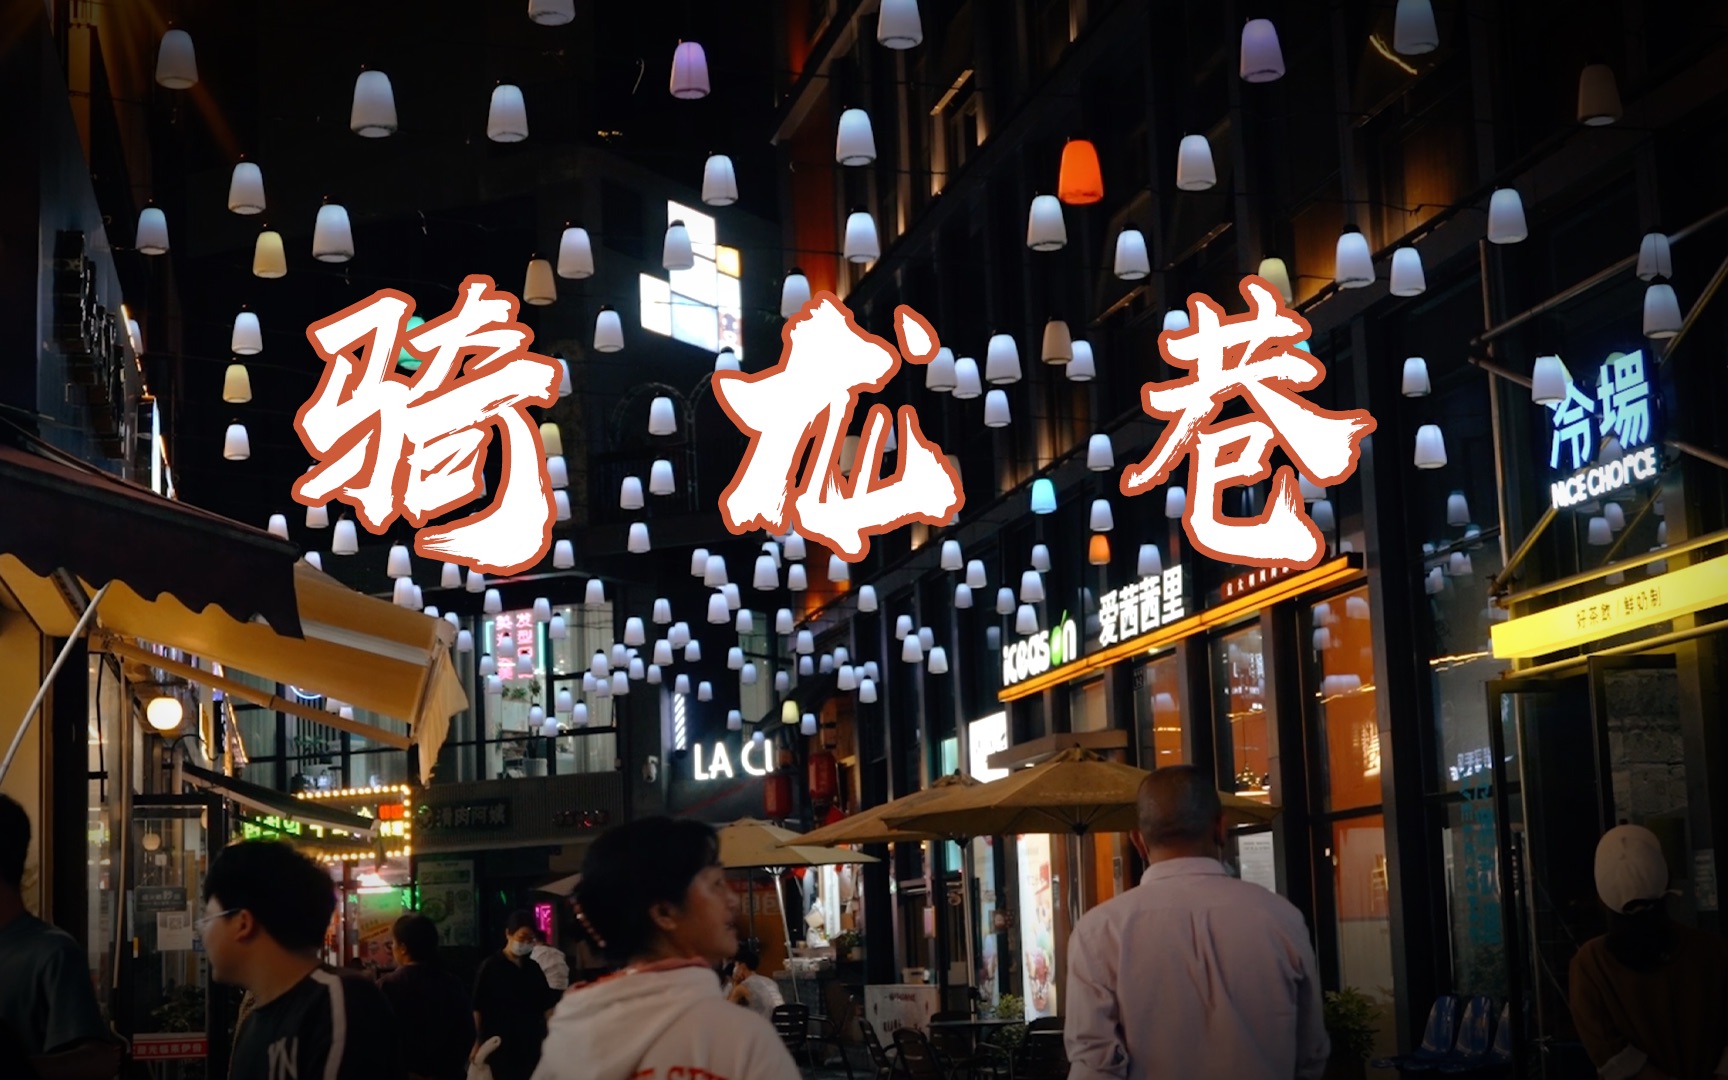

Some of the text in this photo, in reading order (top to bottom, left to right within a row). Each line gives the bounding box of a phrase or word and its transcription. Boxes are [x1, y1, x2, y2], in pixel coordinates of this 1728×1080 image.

[1551, 473, 1587, 509] NICE
[1098, 564, 1185, 647] 爱茜茜里
[694, 741, 734, 780] LA
